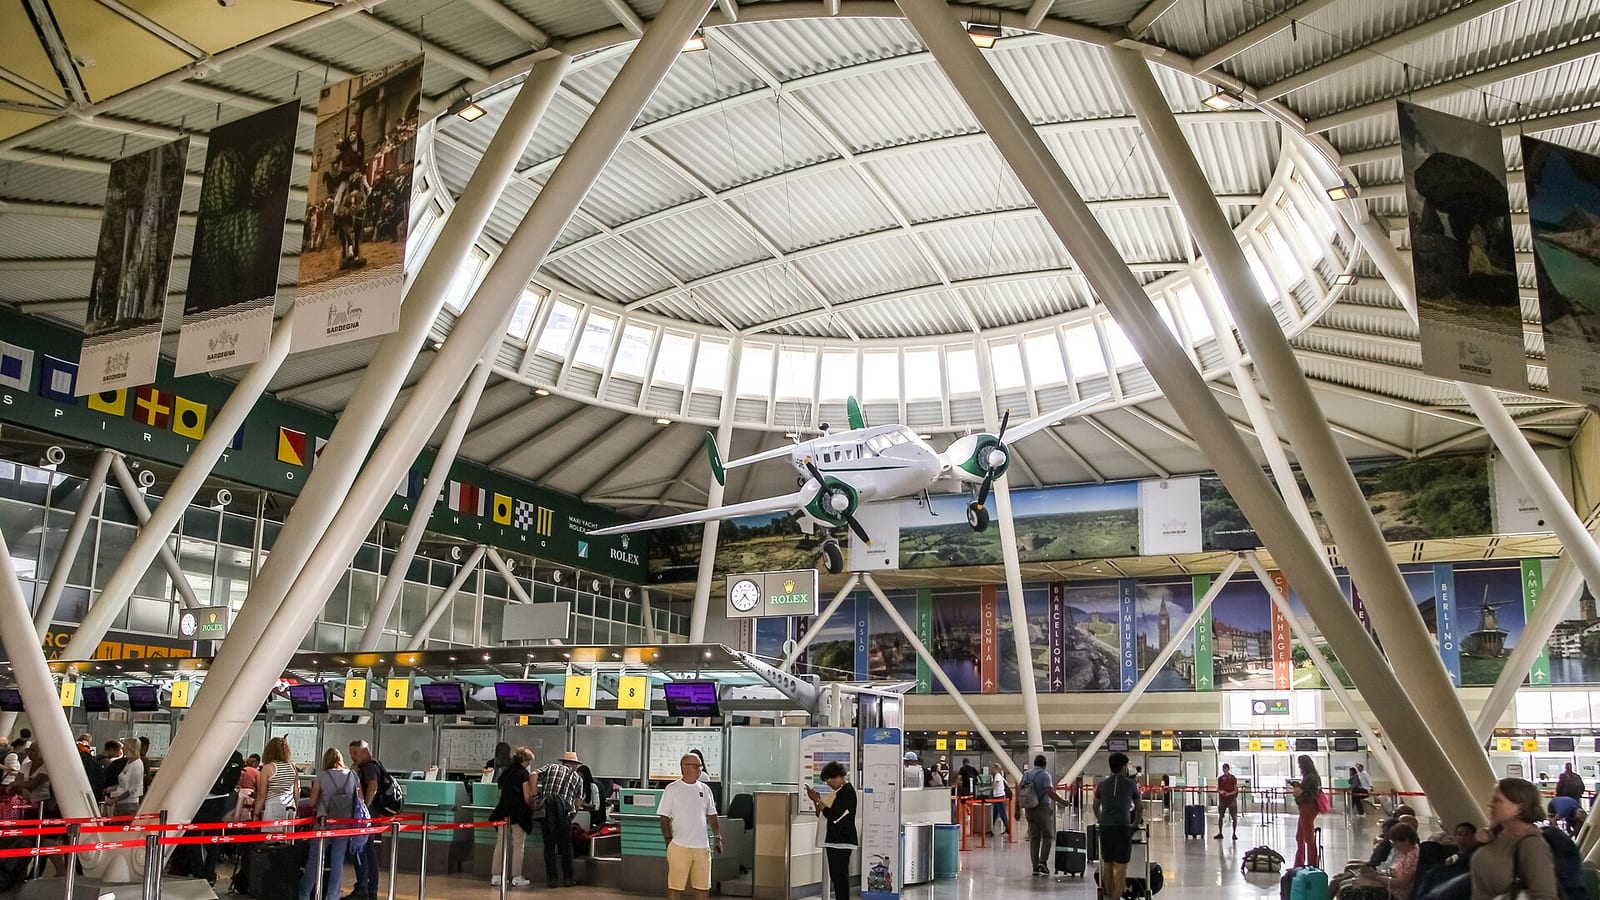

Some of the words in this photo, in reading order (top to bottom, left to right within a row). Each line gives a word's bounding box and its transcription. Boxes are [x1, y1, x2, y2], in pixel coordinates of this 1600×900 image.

[326, 321, 360, 335] SARDEGNA
[206, 349, 236, 361] SARDEGNA
[568, 515, 581, 525] MAXI
[581, 519, 599, 529] YACHT
[568, 523, 586, 533] ROLEX
[610, 548, 640, 566] ROLEX
[770, 594, 808, 605] ROLEX
[1441, 583, 1453, 650] BERLINO
[201, 623, 224, 632] ROLEX
[1053, 587, 1061, 673] BARCELLONA
[1123, 587, 1132, 667] EDIMBURGO
[177, 690, 182, 698] 3
[352, 688, 358, 698] 5
[394, 688, 400, 698] 6
[575, 687, 581, 697] 7
[629, 687, 635, 697] 8
